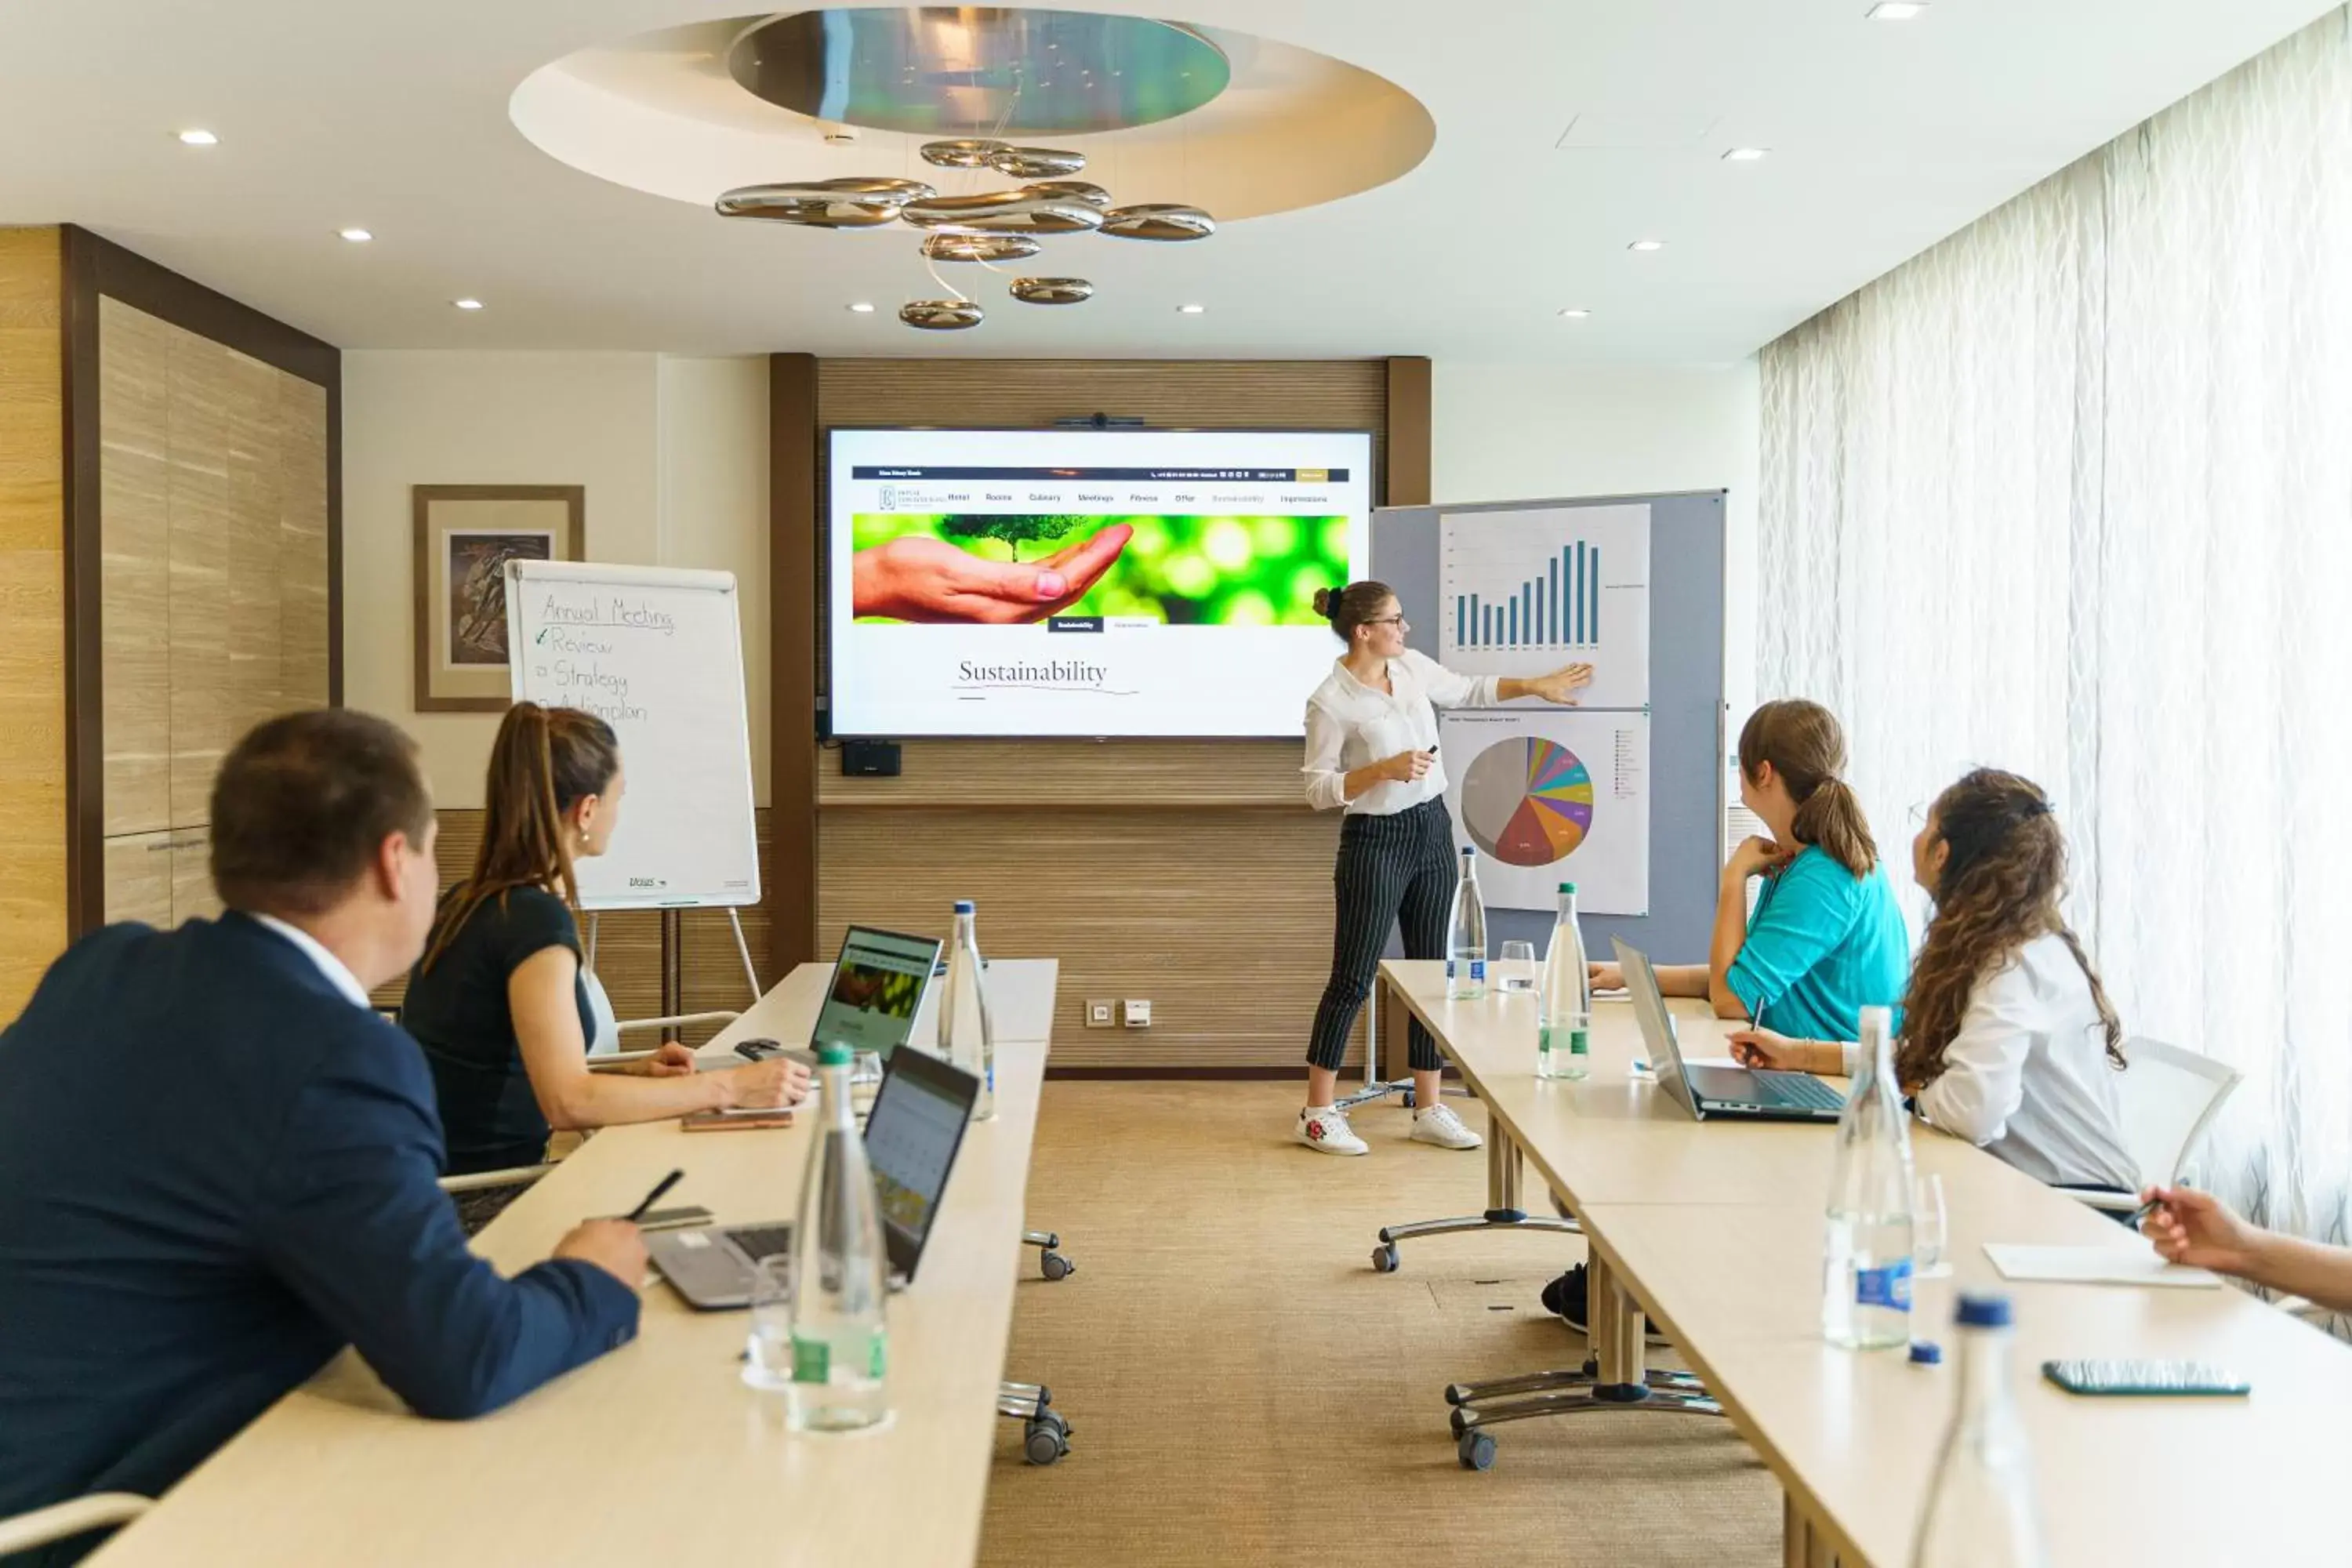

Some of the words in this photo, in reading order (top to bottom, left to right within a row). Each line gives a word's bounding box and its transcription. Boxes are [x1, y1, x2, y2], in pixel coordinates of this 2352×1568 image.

[948, 492, 970, 502] Hotel
[985, 493, 1012, 502] Rooms
[1029, 492, 1062, 503] Culinary
[1078, 493, 1114, 503] Meetings
[1130, 494, 1159, 503] Fitness
[1174, 494, 1196, 503] Offer
[543, 593, 598, 621] Annual
[612, 597, 676, 636] Meeting
[551, 626, 612, 653] Review
[554, 659, 629, 697] Strategy
[958, 659, 1108, 688] Sustainability
[560, 693, 648, 726] Ationplan
